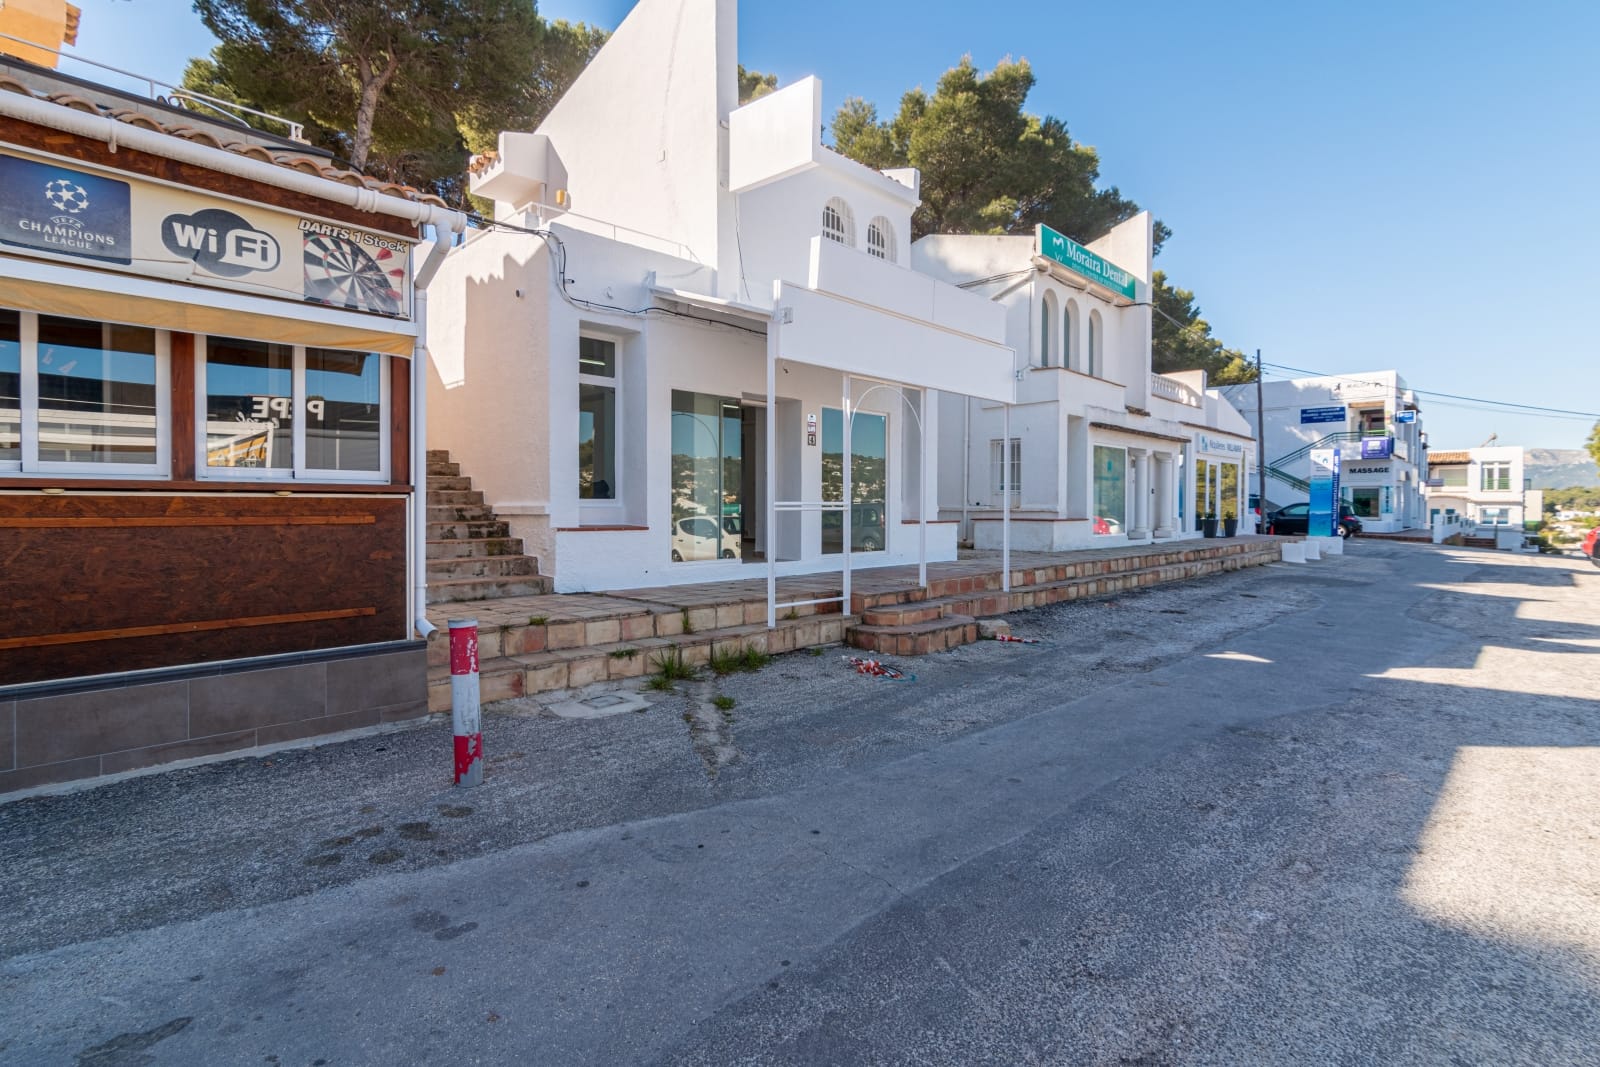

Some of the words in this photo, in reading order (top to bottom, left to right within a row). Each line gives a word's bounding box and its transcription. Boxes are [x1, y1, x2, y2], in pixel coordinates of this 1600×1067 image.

[18, 219, 116, 247] CHAMPIONS
[44, 234, 93, 250] LEAGUE
[298, 218, 351, 240] DARTS
[354, 230, 363, 245] 1
[363, 234, 407, 254] Stock
[1066, 240, 1101, 275] Moraira
[1102, 260, 1129, 289] Dental
